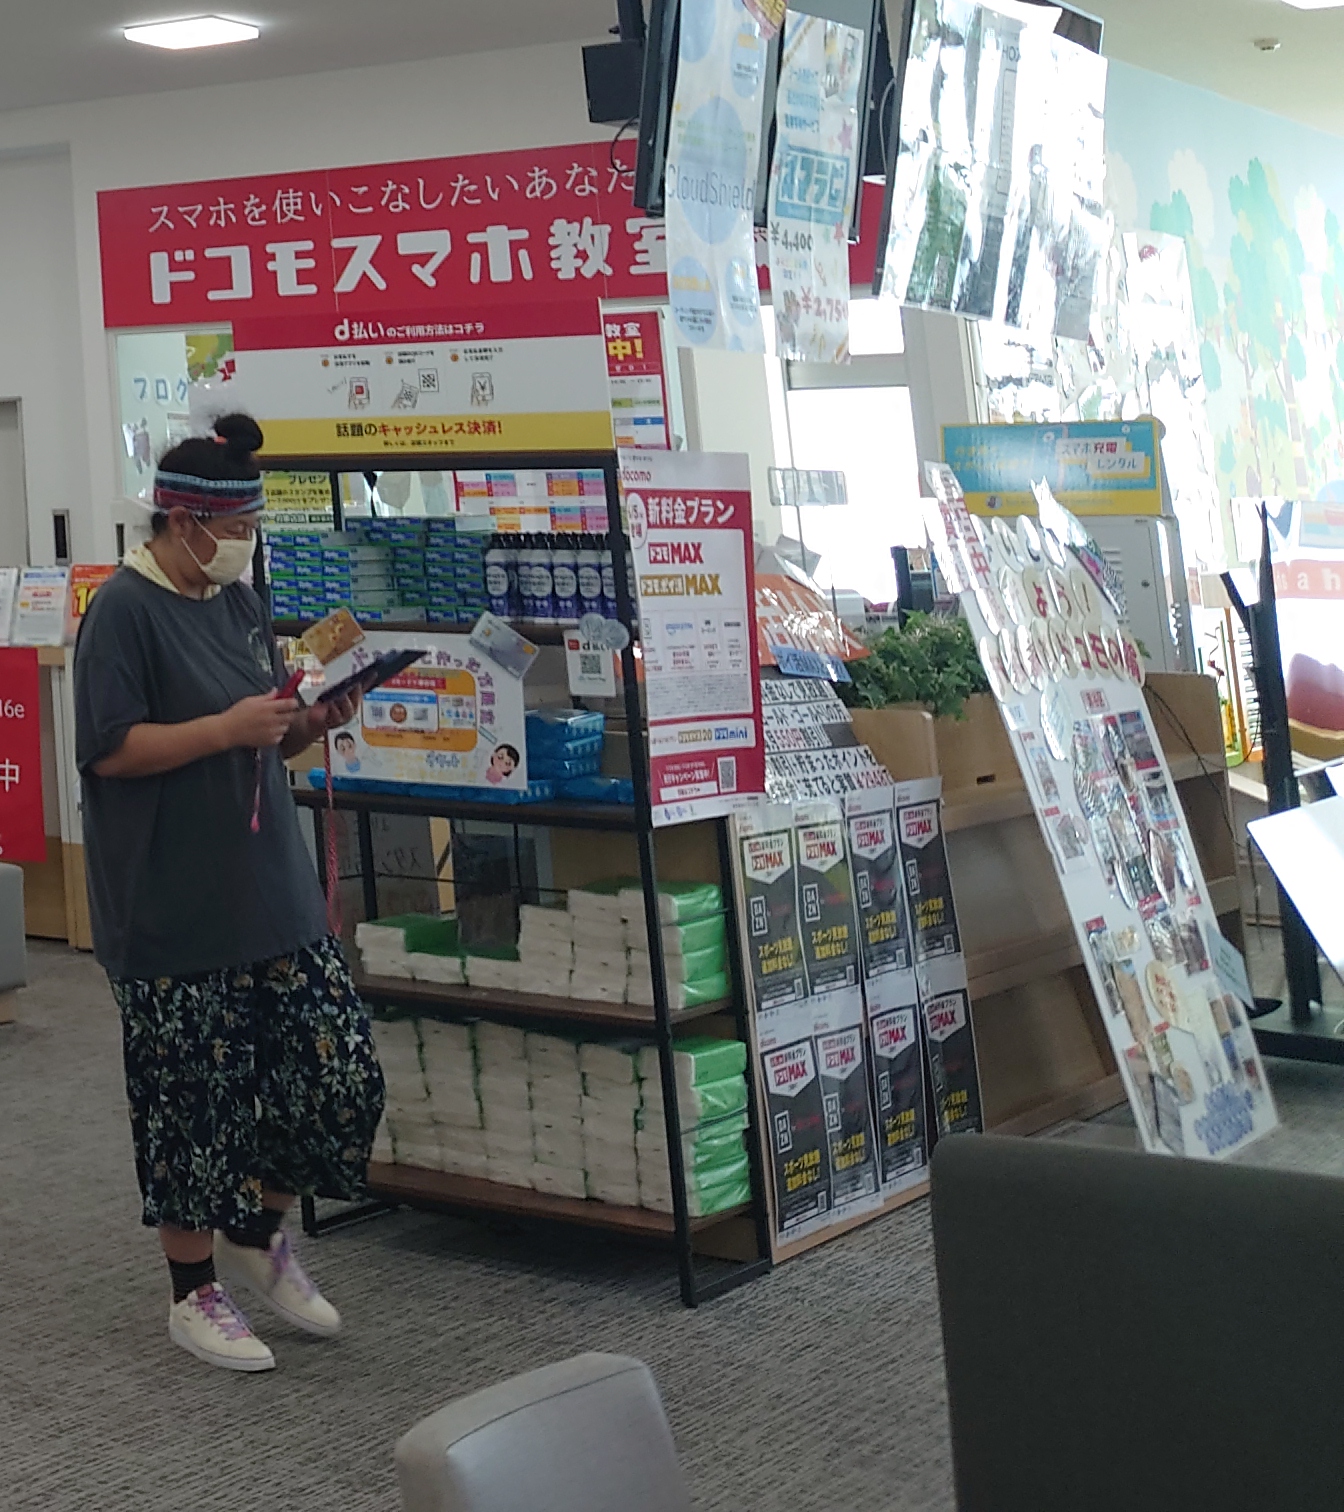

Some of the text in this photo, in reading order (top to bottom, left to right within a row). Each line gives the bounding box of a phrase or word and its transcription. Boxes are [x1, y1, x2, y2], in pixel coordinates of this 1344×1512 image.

[148, 161, 634, 234] スマホを使いこなしたいあなた
[666, 163, 756, 212] CloudShield
[149, 217, 666, 305] ドコモスマホ教室
[334, 318, 485, 341] d払いのご利用方法はコチラ
[336, 420, 502, 438] 話題のキャッシュレス決済!
[1062, 441, 1118, 455] スマホ充電
[1097, 456, 1136, 470] レンタル
[647, 496, 735, 524] 新料金プラン
